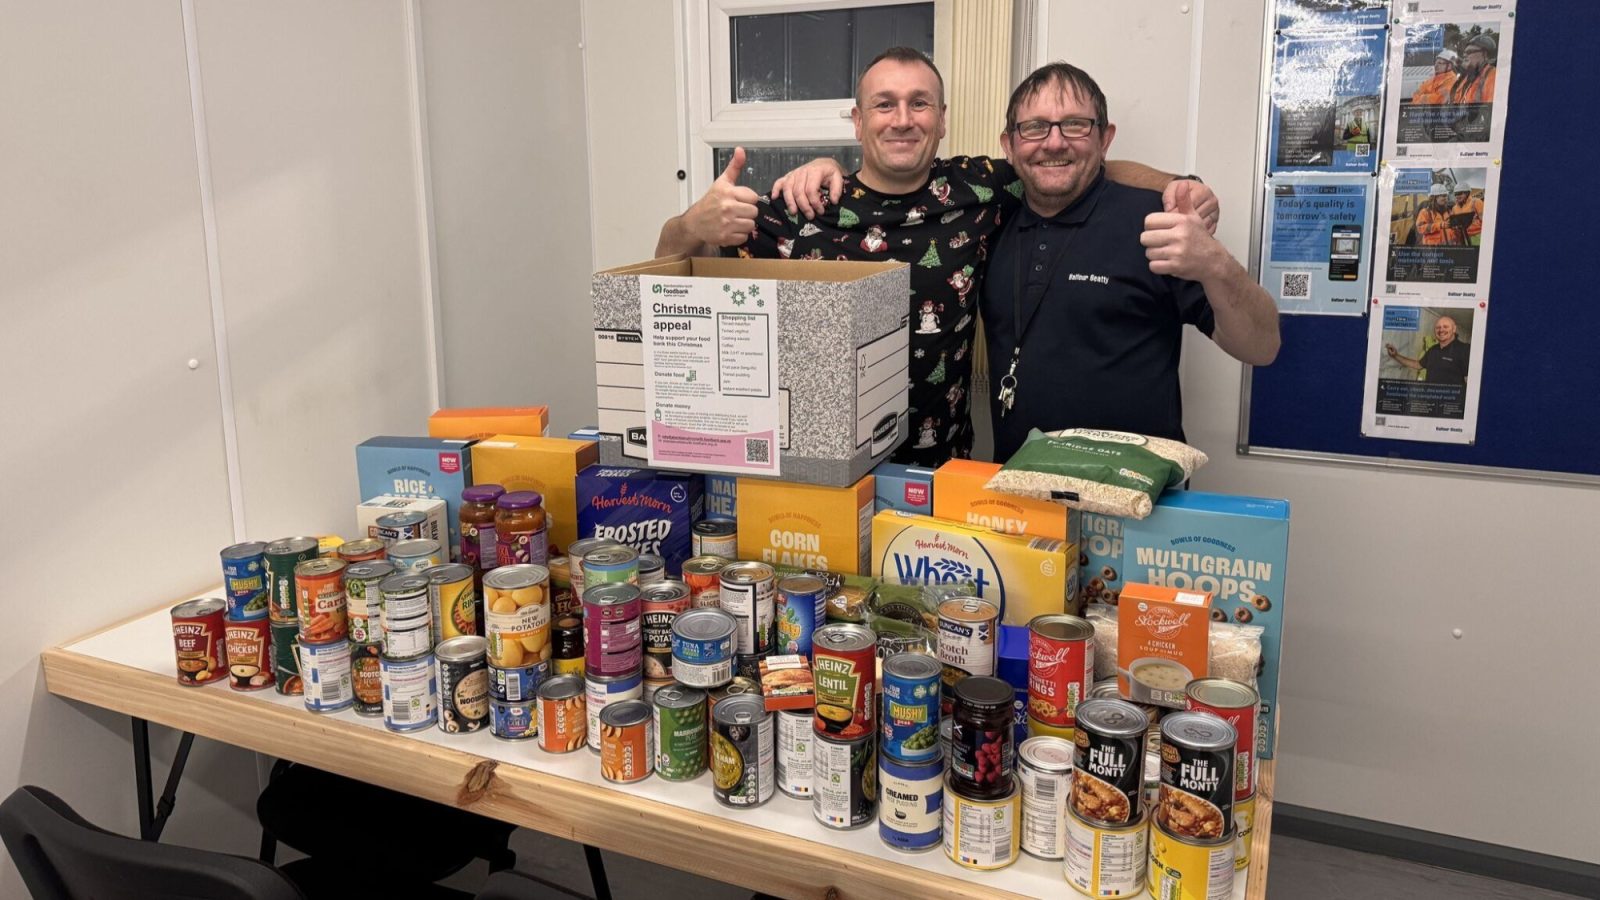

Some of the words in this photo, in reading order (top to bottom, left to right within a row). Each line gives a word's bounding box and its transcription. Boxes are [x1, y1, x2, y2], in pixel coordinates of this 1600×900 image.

[1277, 199, 1311, 208] Today's
[1313, 200, 1345, 210] quality
[1276, 211, 1327, 221] tomorrow's
[1329, 212, 1357, 222] safety
[1068, 273, 1089, 281] Balfour
[1089, 274, 1110, 285] Beatty
[663, 288, 689, 296] Foodbank
[652, 303, 712, 315] Christmas
[653, 320, 692, 332] appeal
[665, 335, 685, 343] support
[1097, 448, 1122, 456] OATS
[393, 478, 427, 494] RICE
[592, 492, 639, 509] Harvest
[640, 493, 673, 515] Morn
[594, 517, 672, 542] FROSTED
[966, 511, 1028, 536] HONEY
[770, 528, 820, 553] CORN
[1170, 537, 1192, 547] BOWLS
[1202, 536, 1237, 553] GOODNESS
[915, 538, 947, 551] Harvest
[947, 545, 970, 561] Morn
[1136, 547, 1272, 581] MULTIGRAIN
[232, 577, 258, 589] MUSHY
[1147, 569, 1257, 604] HOOPS
[521, 615, 539, 625] NEW
[646, 613, 673, 623] HEINZ
[1134, 612, 1192, 628] Stockwell
[175, 624, 202, 636] HEINZ
[227, 629, 254, 640] HEINZ
[178, 638, 197, 648] BEEF
[648, 633, 673, 643] POTAT
[227, 644, 258, 654] CHICKEN
[682, 641, 699, 649] TUNA
[1139, 645, 1159, 653] SOUP
[1151, 640, 1176, 650] CHICKEN
[817, 659, 850, 673] HEINZ
[818, 674, 849, 691] LENTIL
[892, 705, 924, 720] MUSHY
[1101, 744, 1116, 753] THE
[1089, 748, 1127, 770] FULL
[1192, 758, 1209, 768] THE
[1088, 762, 1126, 778] MONTY
[1180, 763, 1220, 783] FULL
[1179, 777, 1219, 792] MONTY
[885, 789, 919, 803] CREAMED
[896, 798, 918, 808] PUDDING
